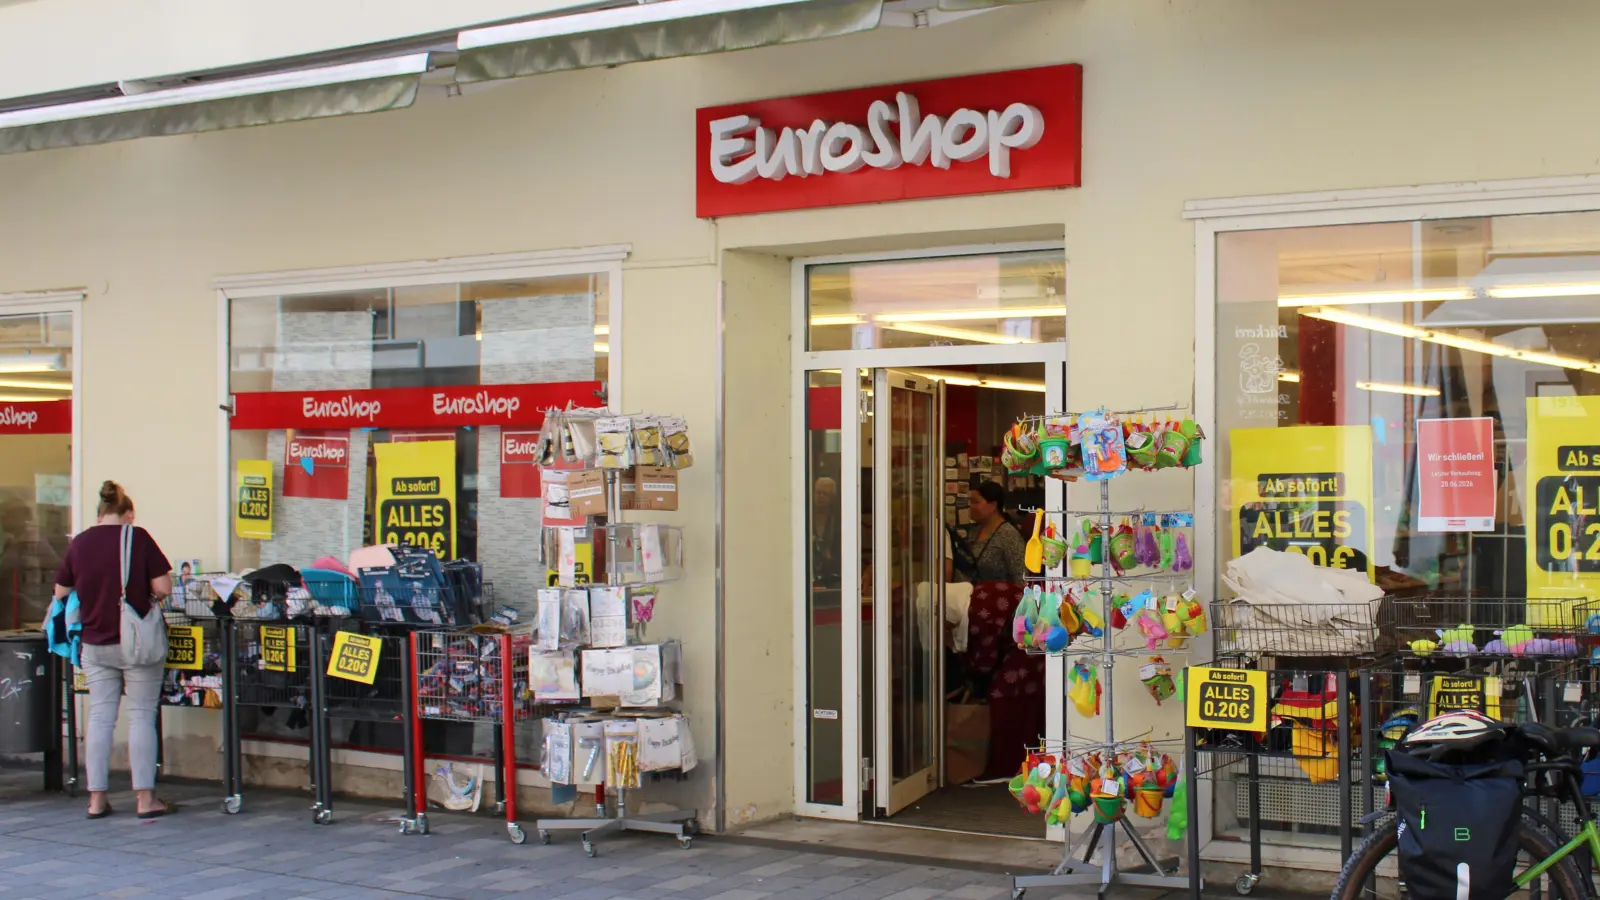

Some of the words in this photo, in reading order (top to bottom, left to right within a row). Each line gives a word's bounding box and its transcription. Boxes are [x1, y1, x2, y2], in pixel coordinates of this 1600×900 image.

[1428, 454, 1442, 462] Wir
[1443, 452, 1484, 461] schließen!
[1566, 450, 1588, 466] Ab
[396, 480, 407, 492] Ab
[408, 480, 437, 492] sofort!
[1265, 478, 1284, 492] Ab
[1288, 477, 1338, 492] sofort!
[241, 490, 268, 502] ALLES
[241, 502, 268, 516] 0.20€
[387, 506, 444, 528] ALLES
[1252, 510, 1352, 539] ALLES
[342, 646, 370, 660] ALLES
[338, 657, 368, 674] 0.20€
[1223, 673, 1245, 681] sofort!
[1204, 686, 1250, 700] ALLES
[1439, 694, 1480, 708] ALLES
[1204, 700, 1250, 719] 0.20€
